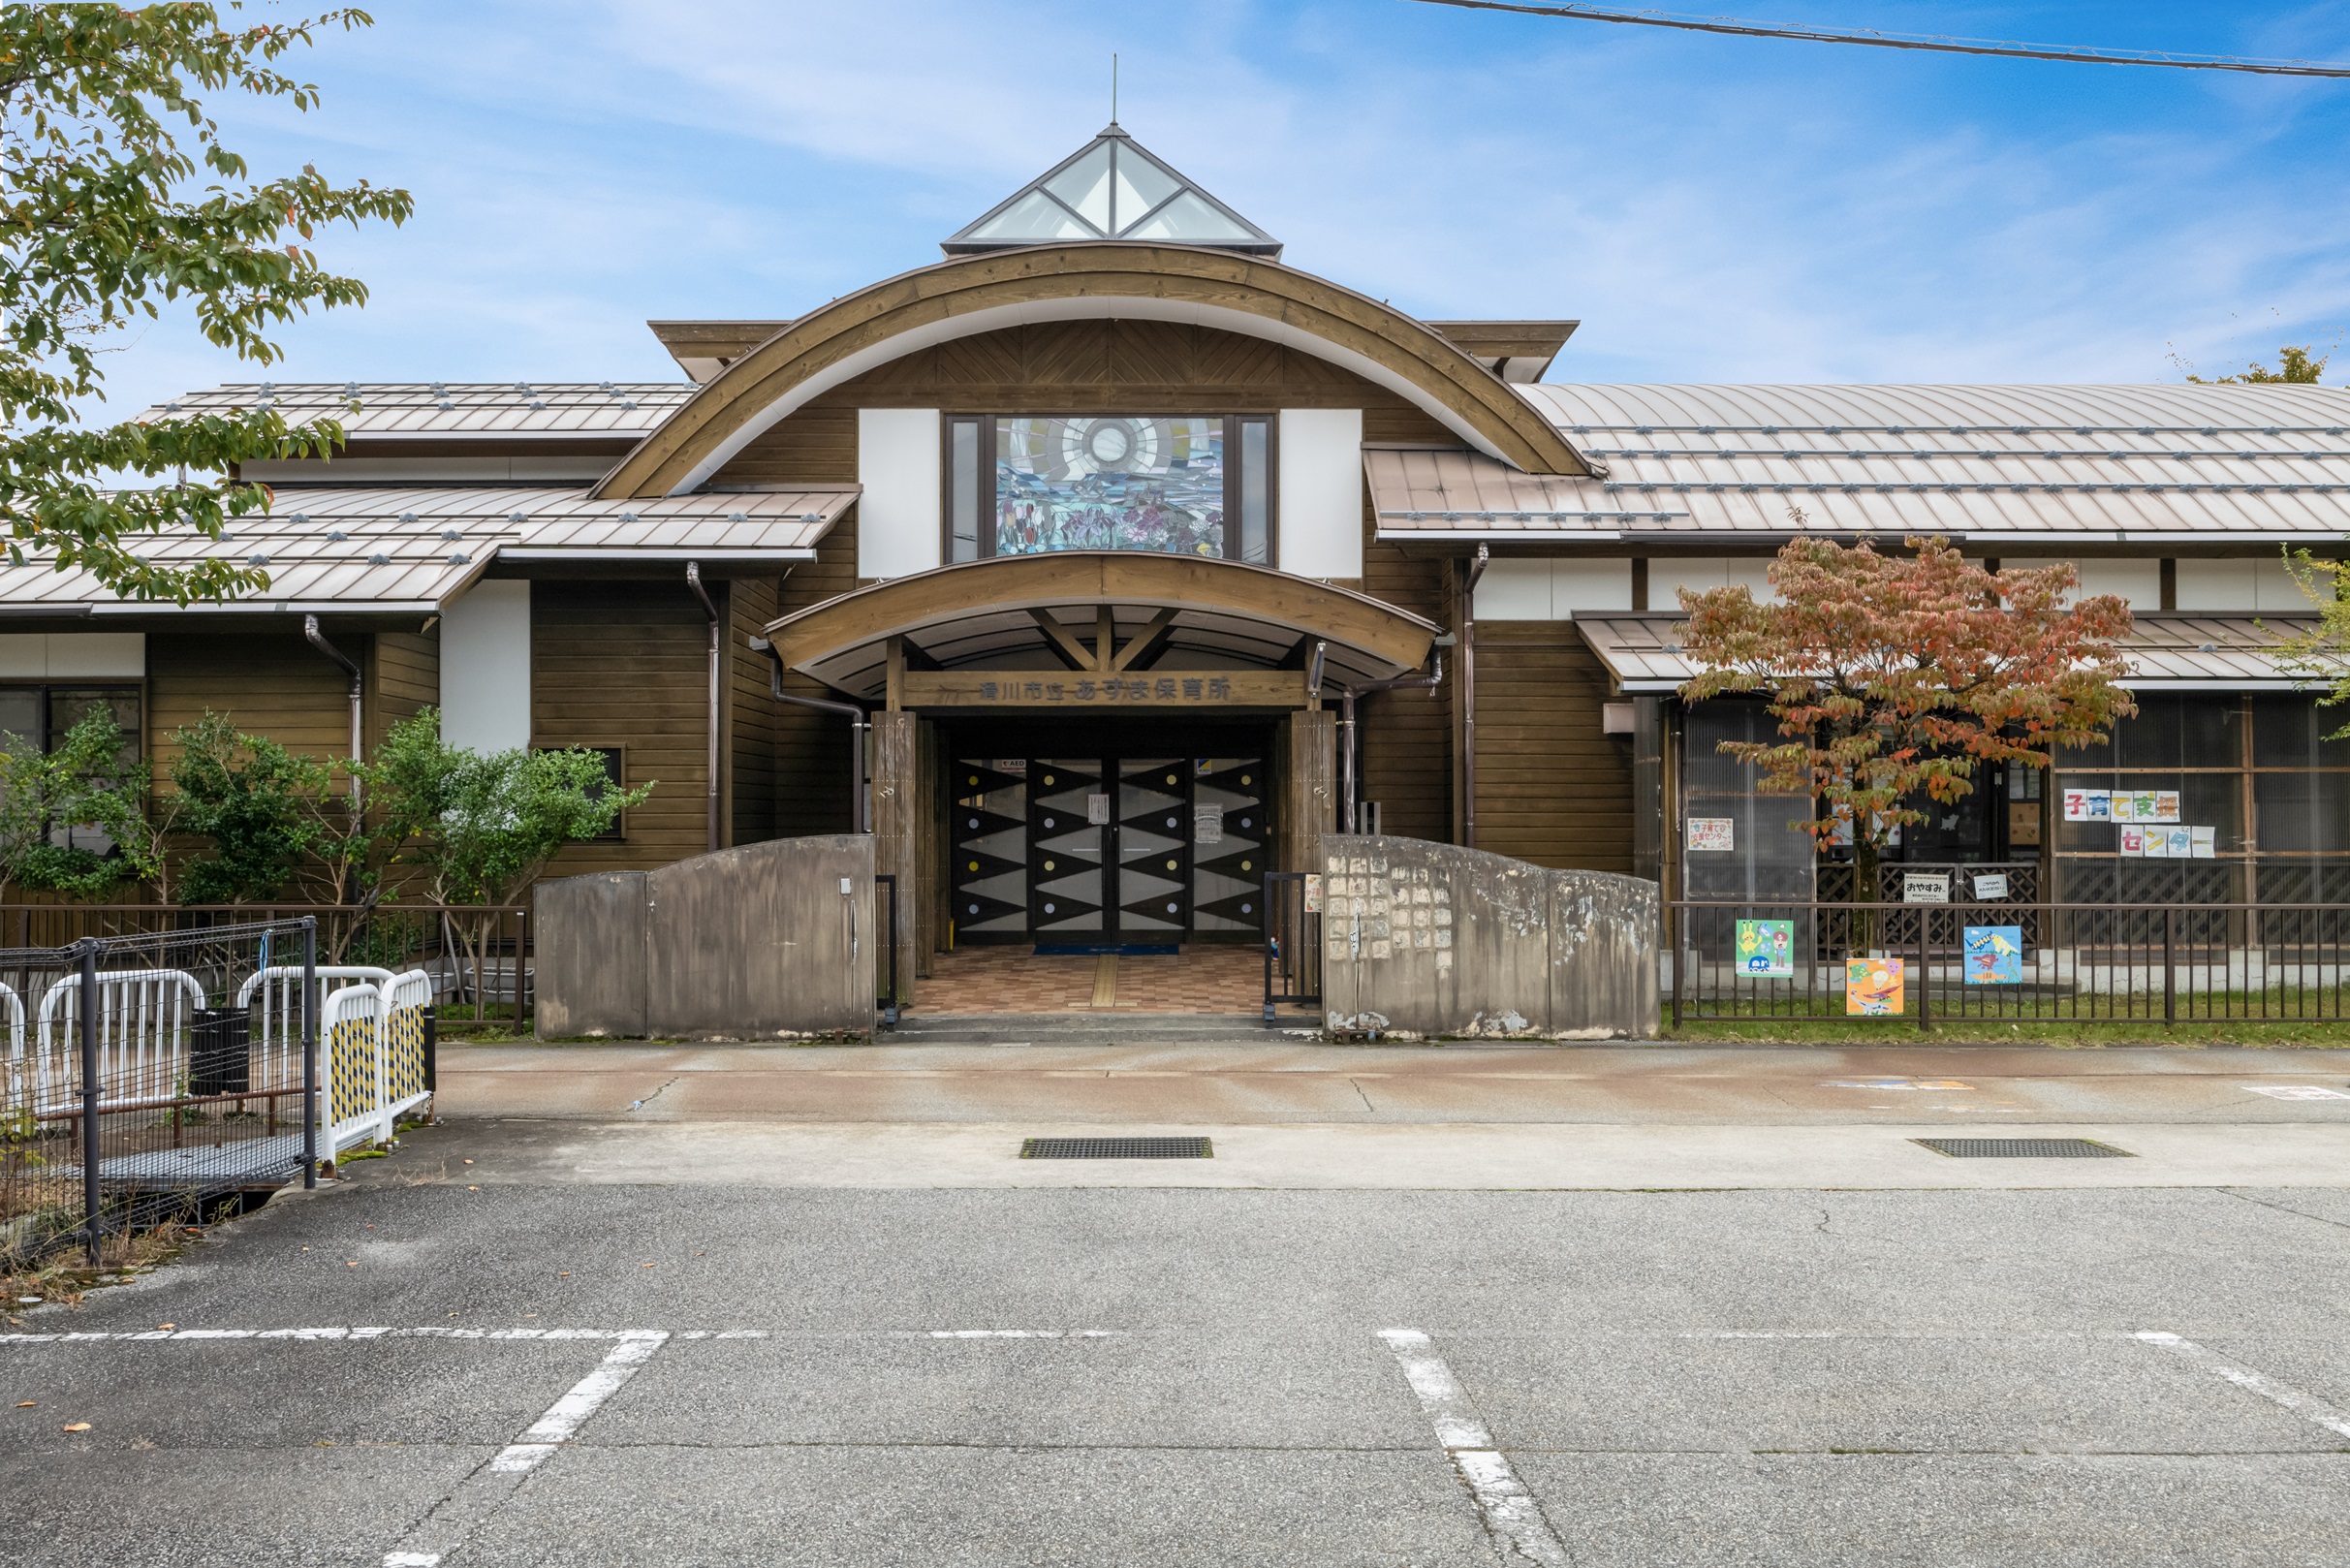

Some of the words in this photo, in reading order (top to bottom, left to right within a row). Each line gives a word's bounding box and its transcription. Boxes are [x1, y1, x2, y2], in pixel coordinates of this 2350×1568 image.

[2065, 794, 2178, 818] 子育て支援
[1701, 824, 1719, 832] 子育て
[1690, 832, 1728, 842] 支援センター
[2122, 830, 2213, 852] センター
[1906, 882, 1942, 893] おやすみ
